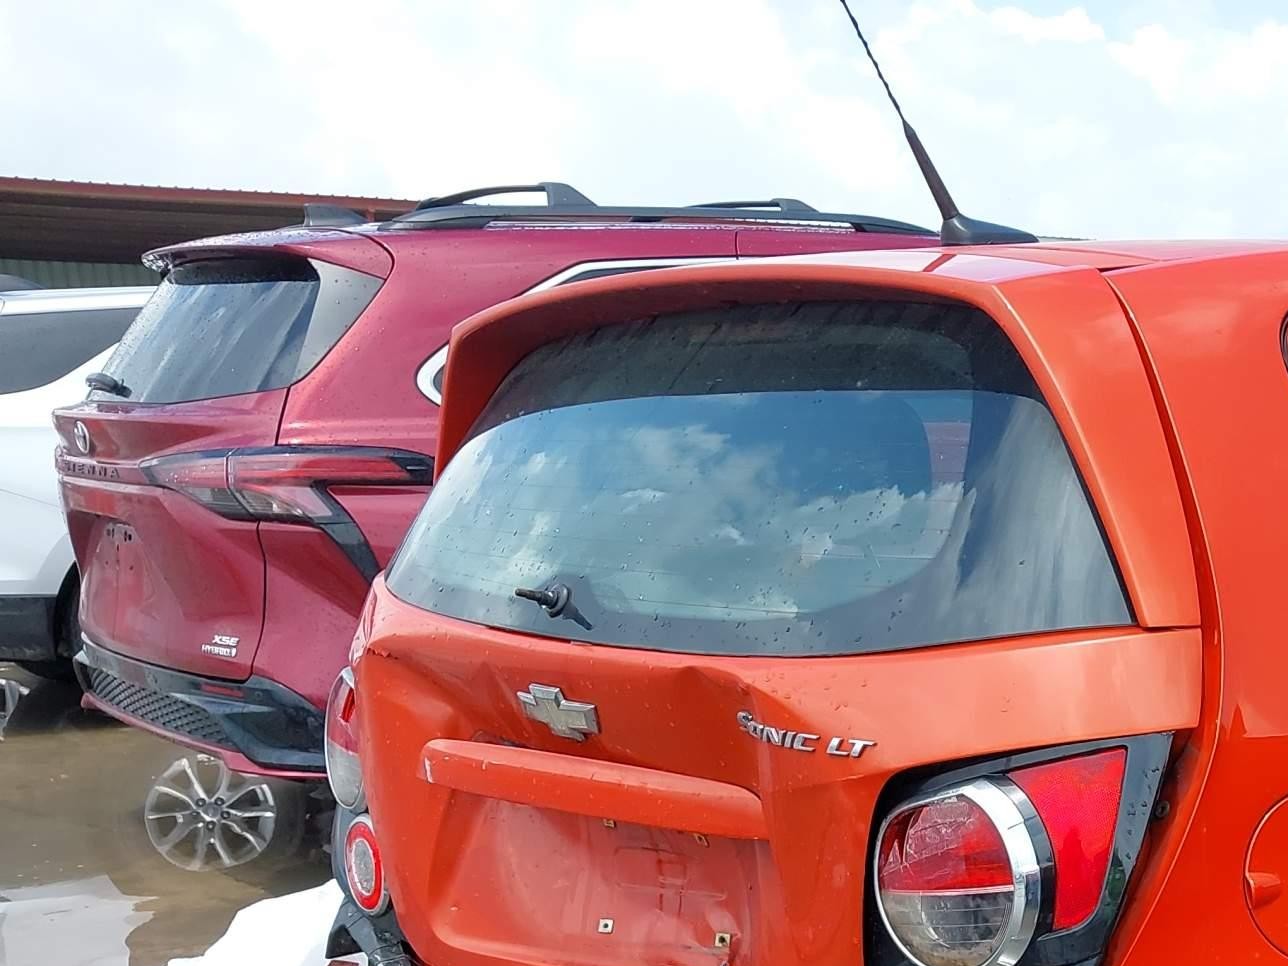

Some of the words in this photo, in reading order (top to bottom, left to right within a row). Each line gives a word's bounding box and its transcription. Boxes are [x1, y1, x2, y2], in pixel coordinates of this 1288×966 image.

[212, 634, 240, 646] XSE
[201, 644, 231, 657] HYBRID
[736, 711, 820, 752] SONIC
[826, 737, 877, 757] LT
